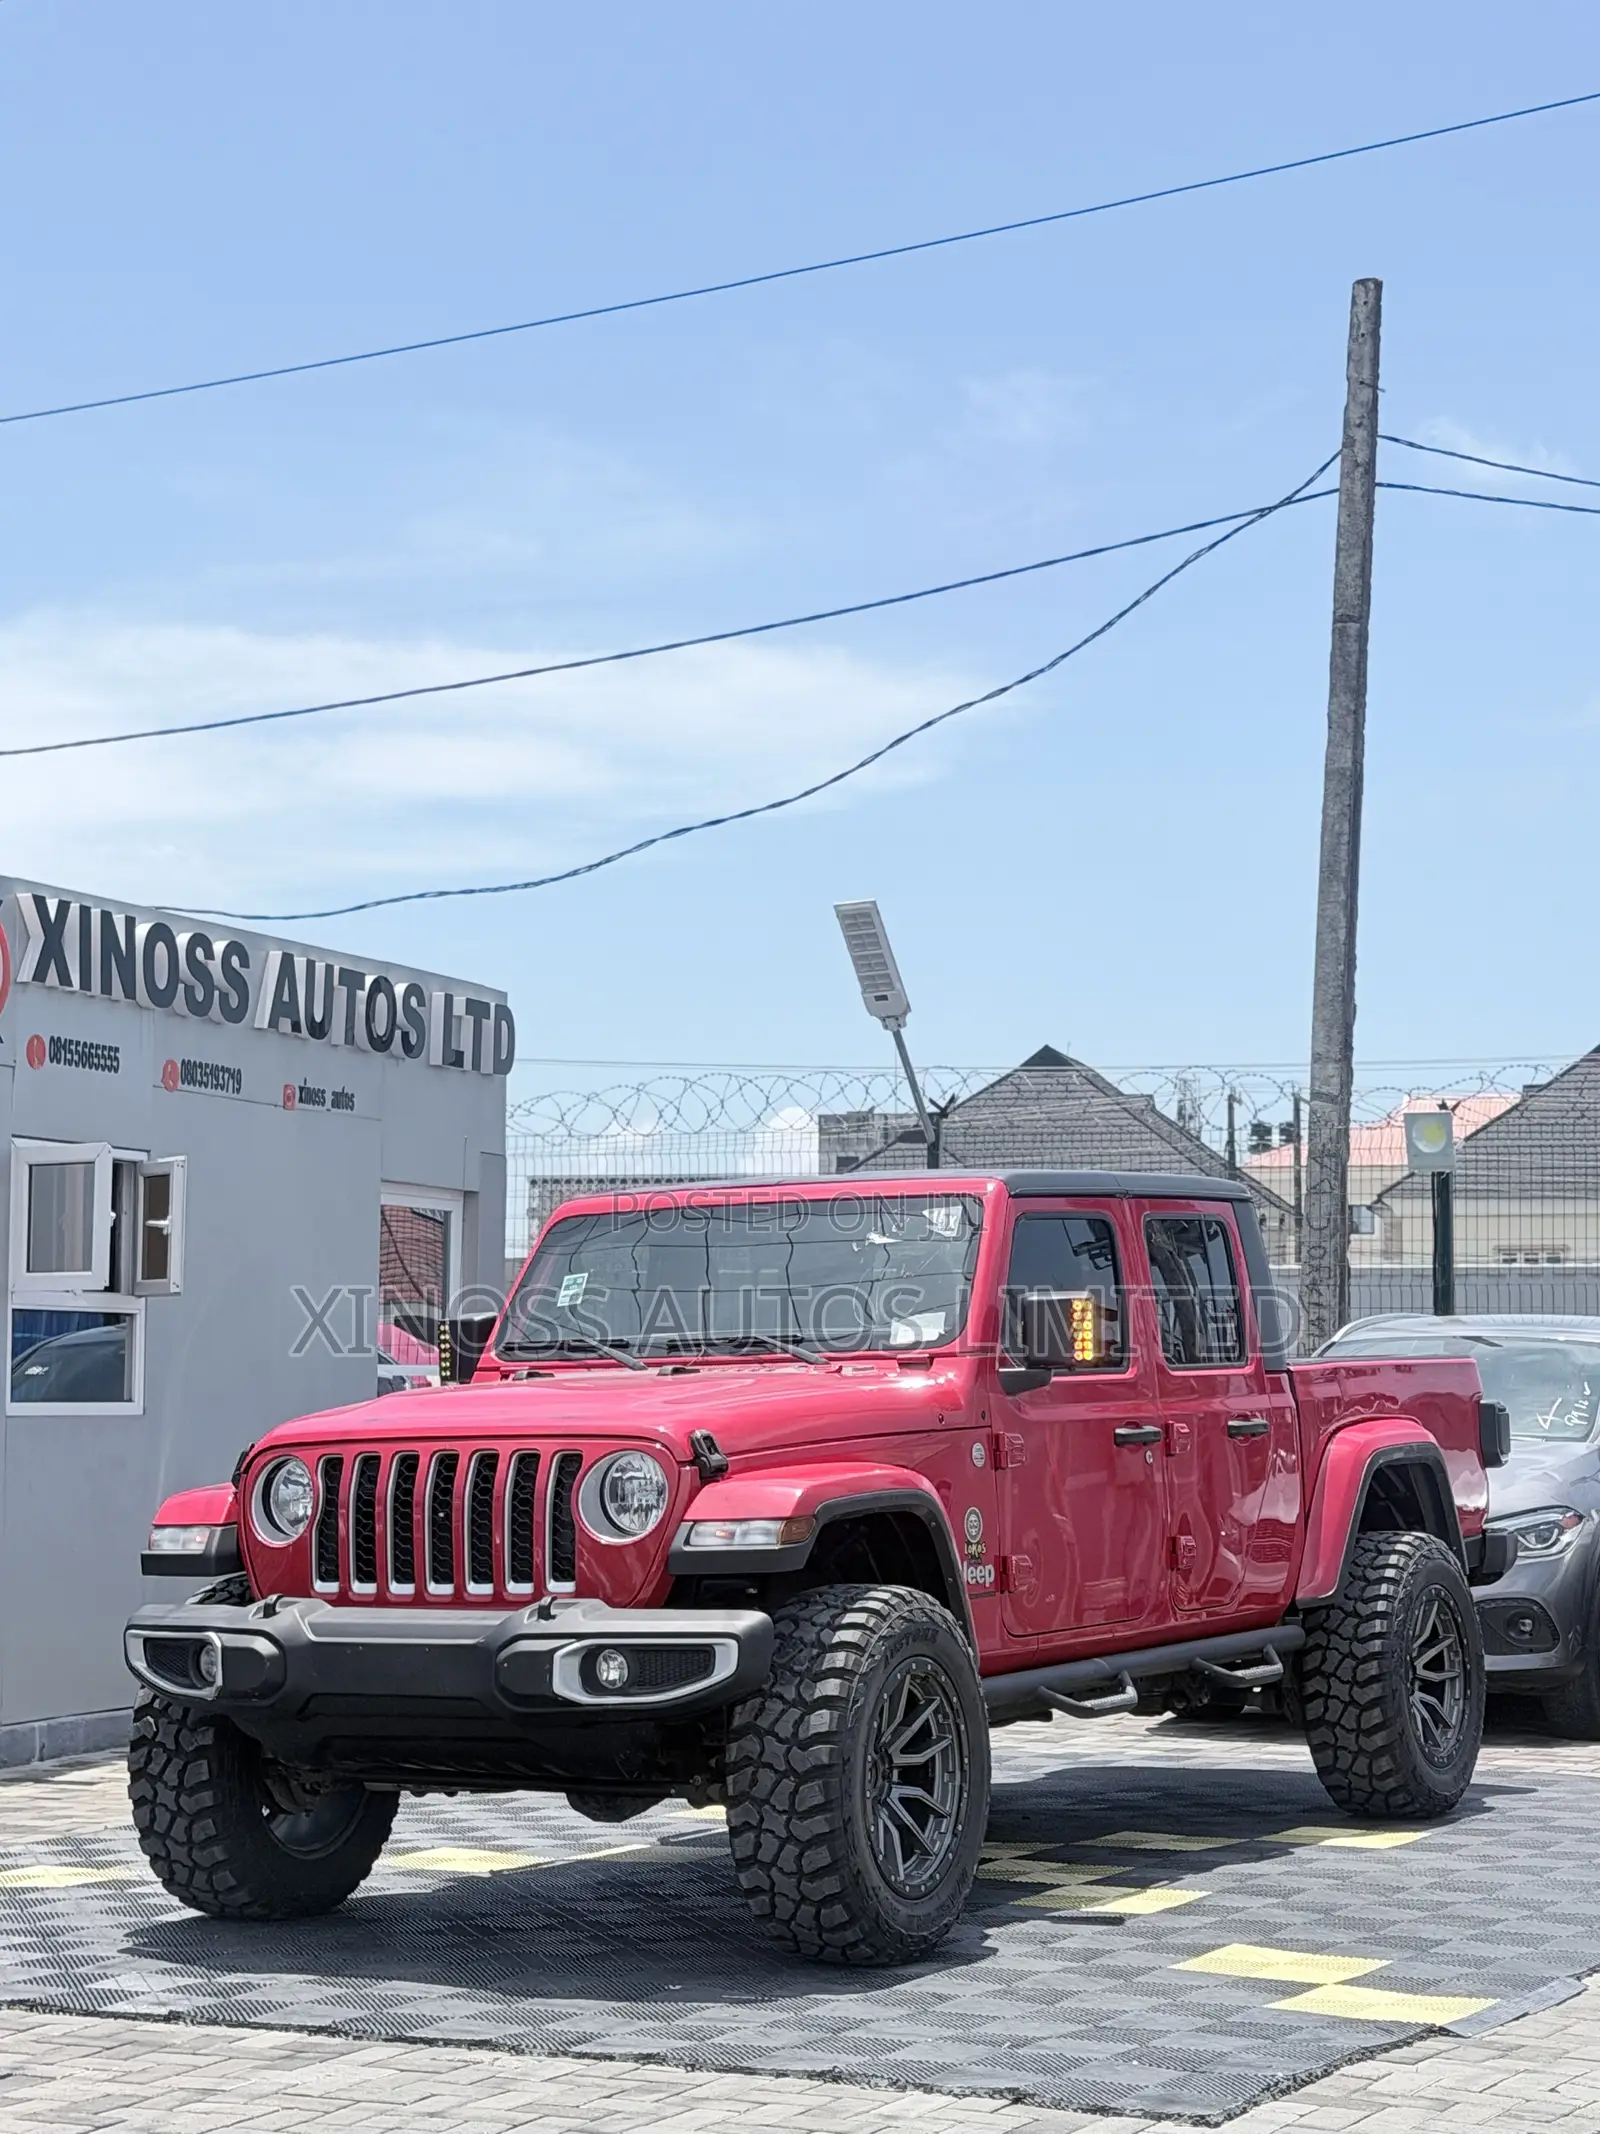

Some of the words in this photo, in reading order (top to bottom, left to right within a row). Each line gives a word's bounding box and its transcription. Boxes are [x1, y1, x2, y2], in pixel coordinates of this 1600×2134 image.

[28, 893, 250, 1024] XINOSS
[262, 951, 426, 1059] AUTOS
[438, 992, 516, 1076] LTD
[48, 1035, 120, 1074] 08155665555
[180, 1058, 242, 1095] 08035193719
[298, 1077, 355, 1112] xinoss_autos
